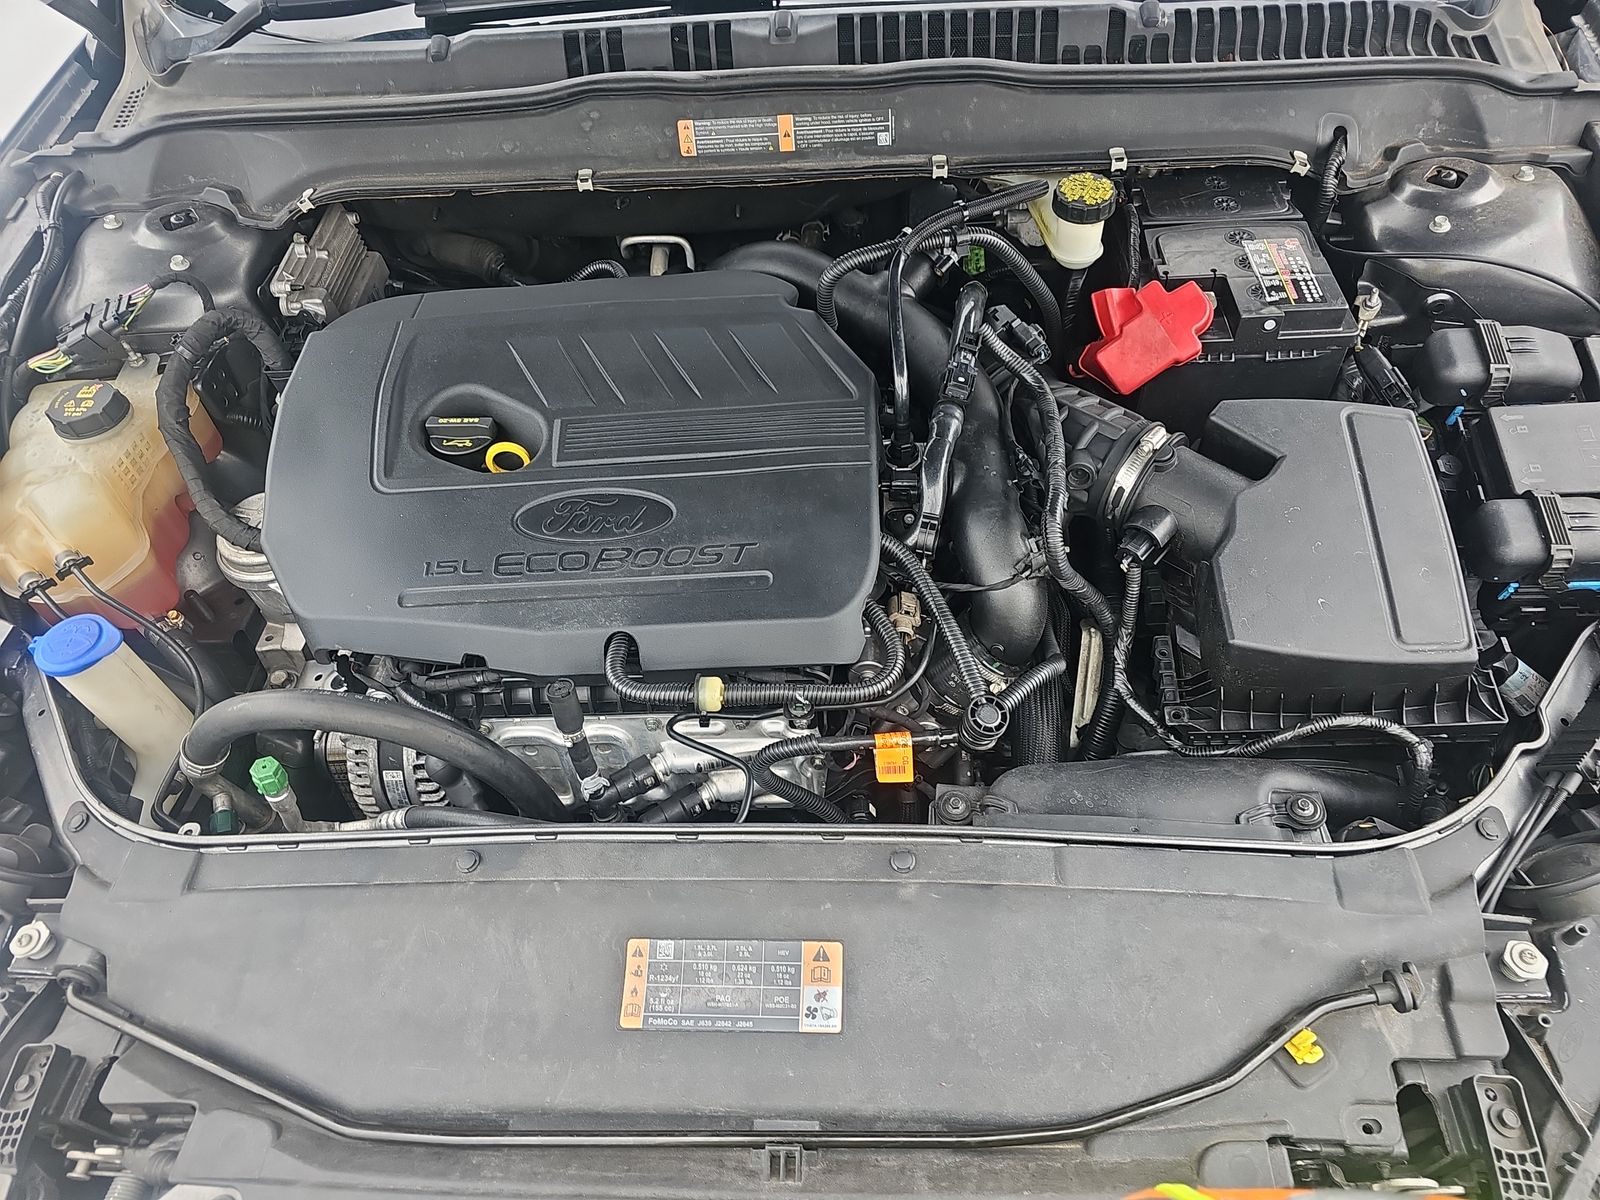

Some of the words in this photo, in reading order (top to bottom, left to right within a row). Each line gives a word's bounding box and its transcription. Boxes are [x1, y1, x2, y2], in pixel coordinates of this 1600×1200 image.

[541, 498, 647, 536] Ford
[649, 974, 679, 984] R-1234yf
[715, 994, 731, 1003] PAG
[774, 996, 790, 1004] POE
[648, 1017, 679, 1026] FoMoCo
